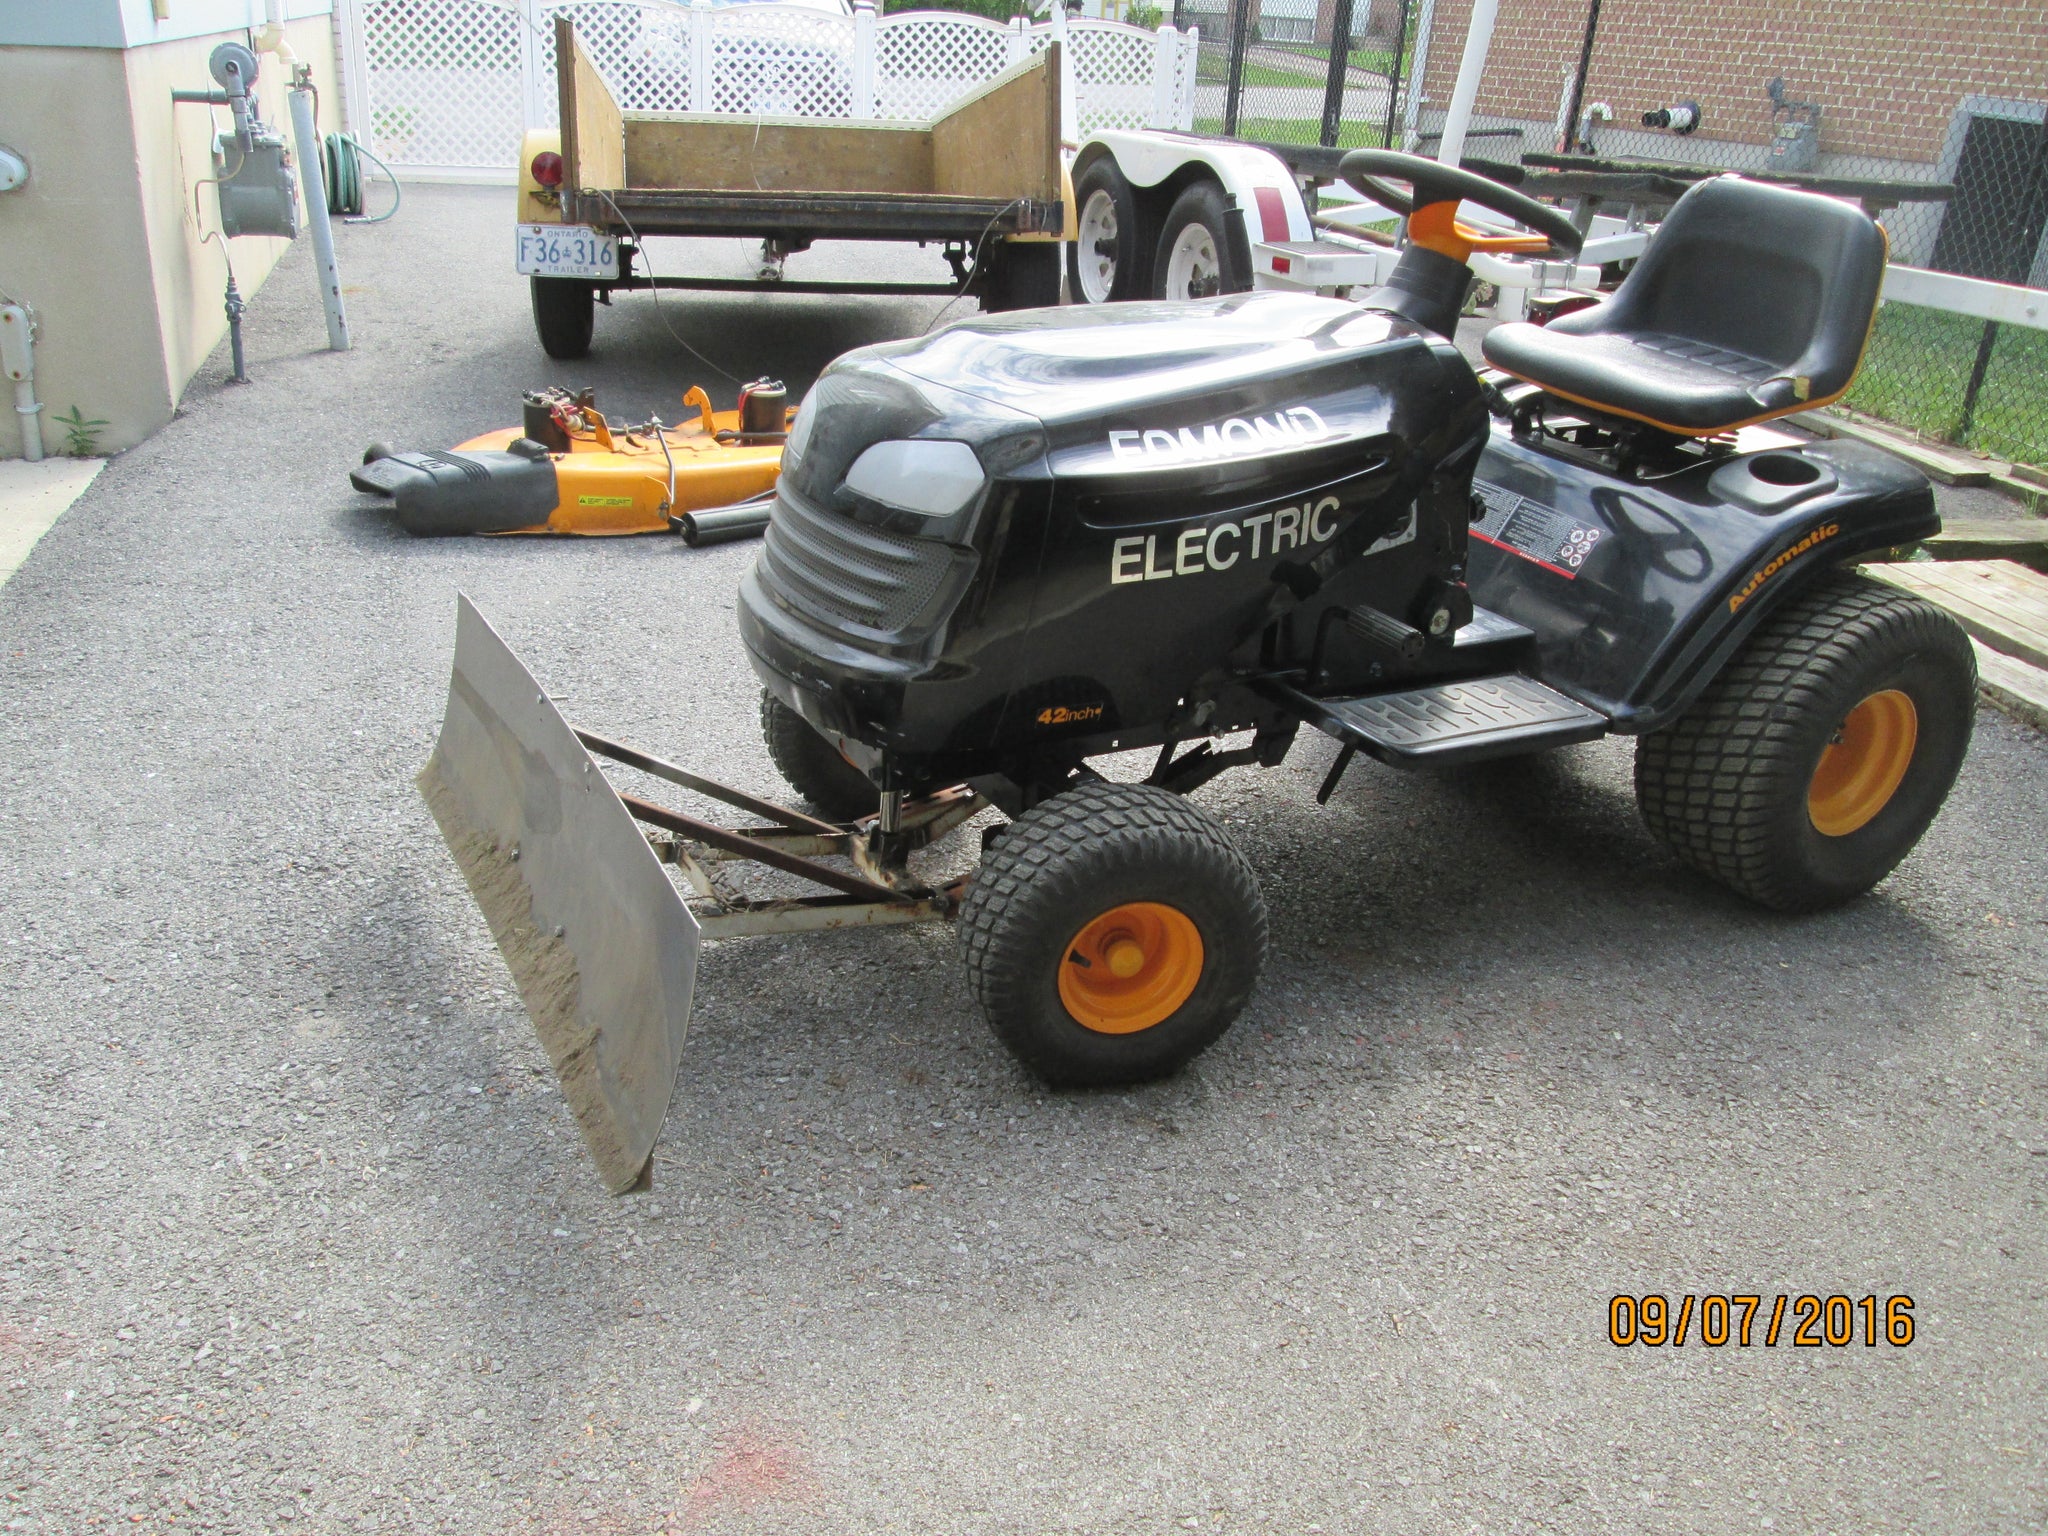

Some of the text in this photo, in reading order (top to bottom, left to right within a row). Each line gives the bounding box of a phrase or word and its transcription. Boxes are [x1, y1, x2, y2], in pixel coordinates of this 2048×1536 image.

[547, 230, 589, 238] ONTARIO
[548, 265, 589, 273] TRAILER
[1109, 405, 1329, 462] EDMOND
[1111, 496, 1340, 584] ELECTRIC
[1729, 523, 1839, 614] Automatic
